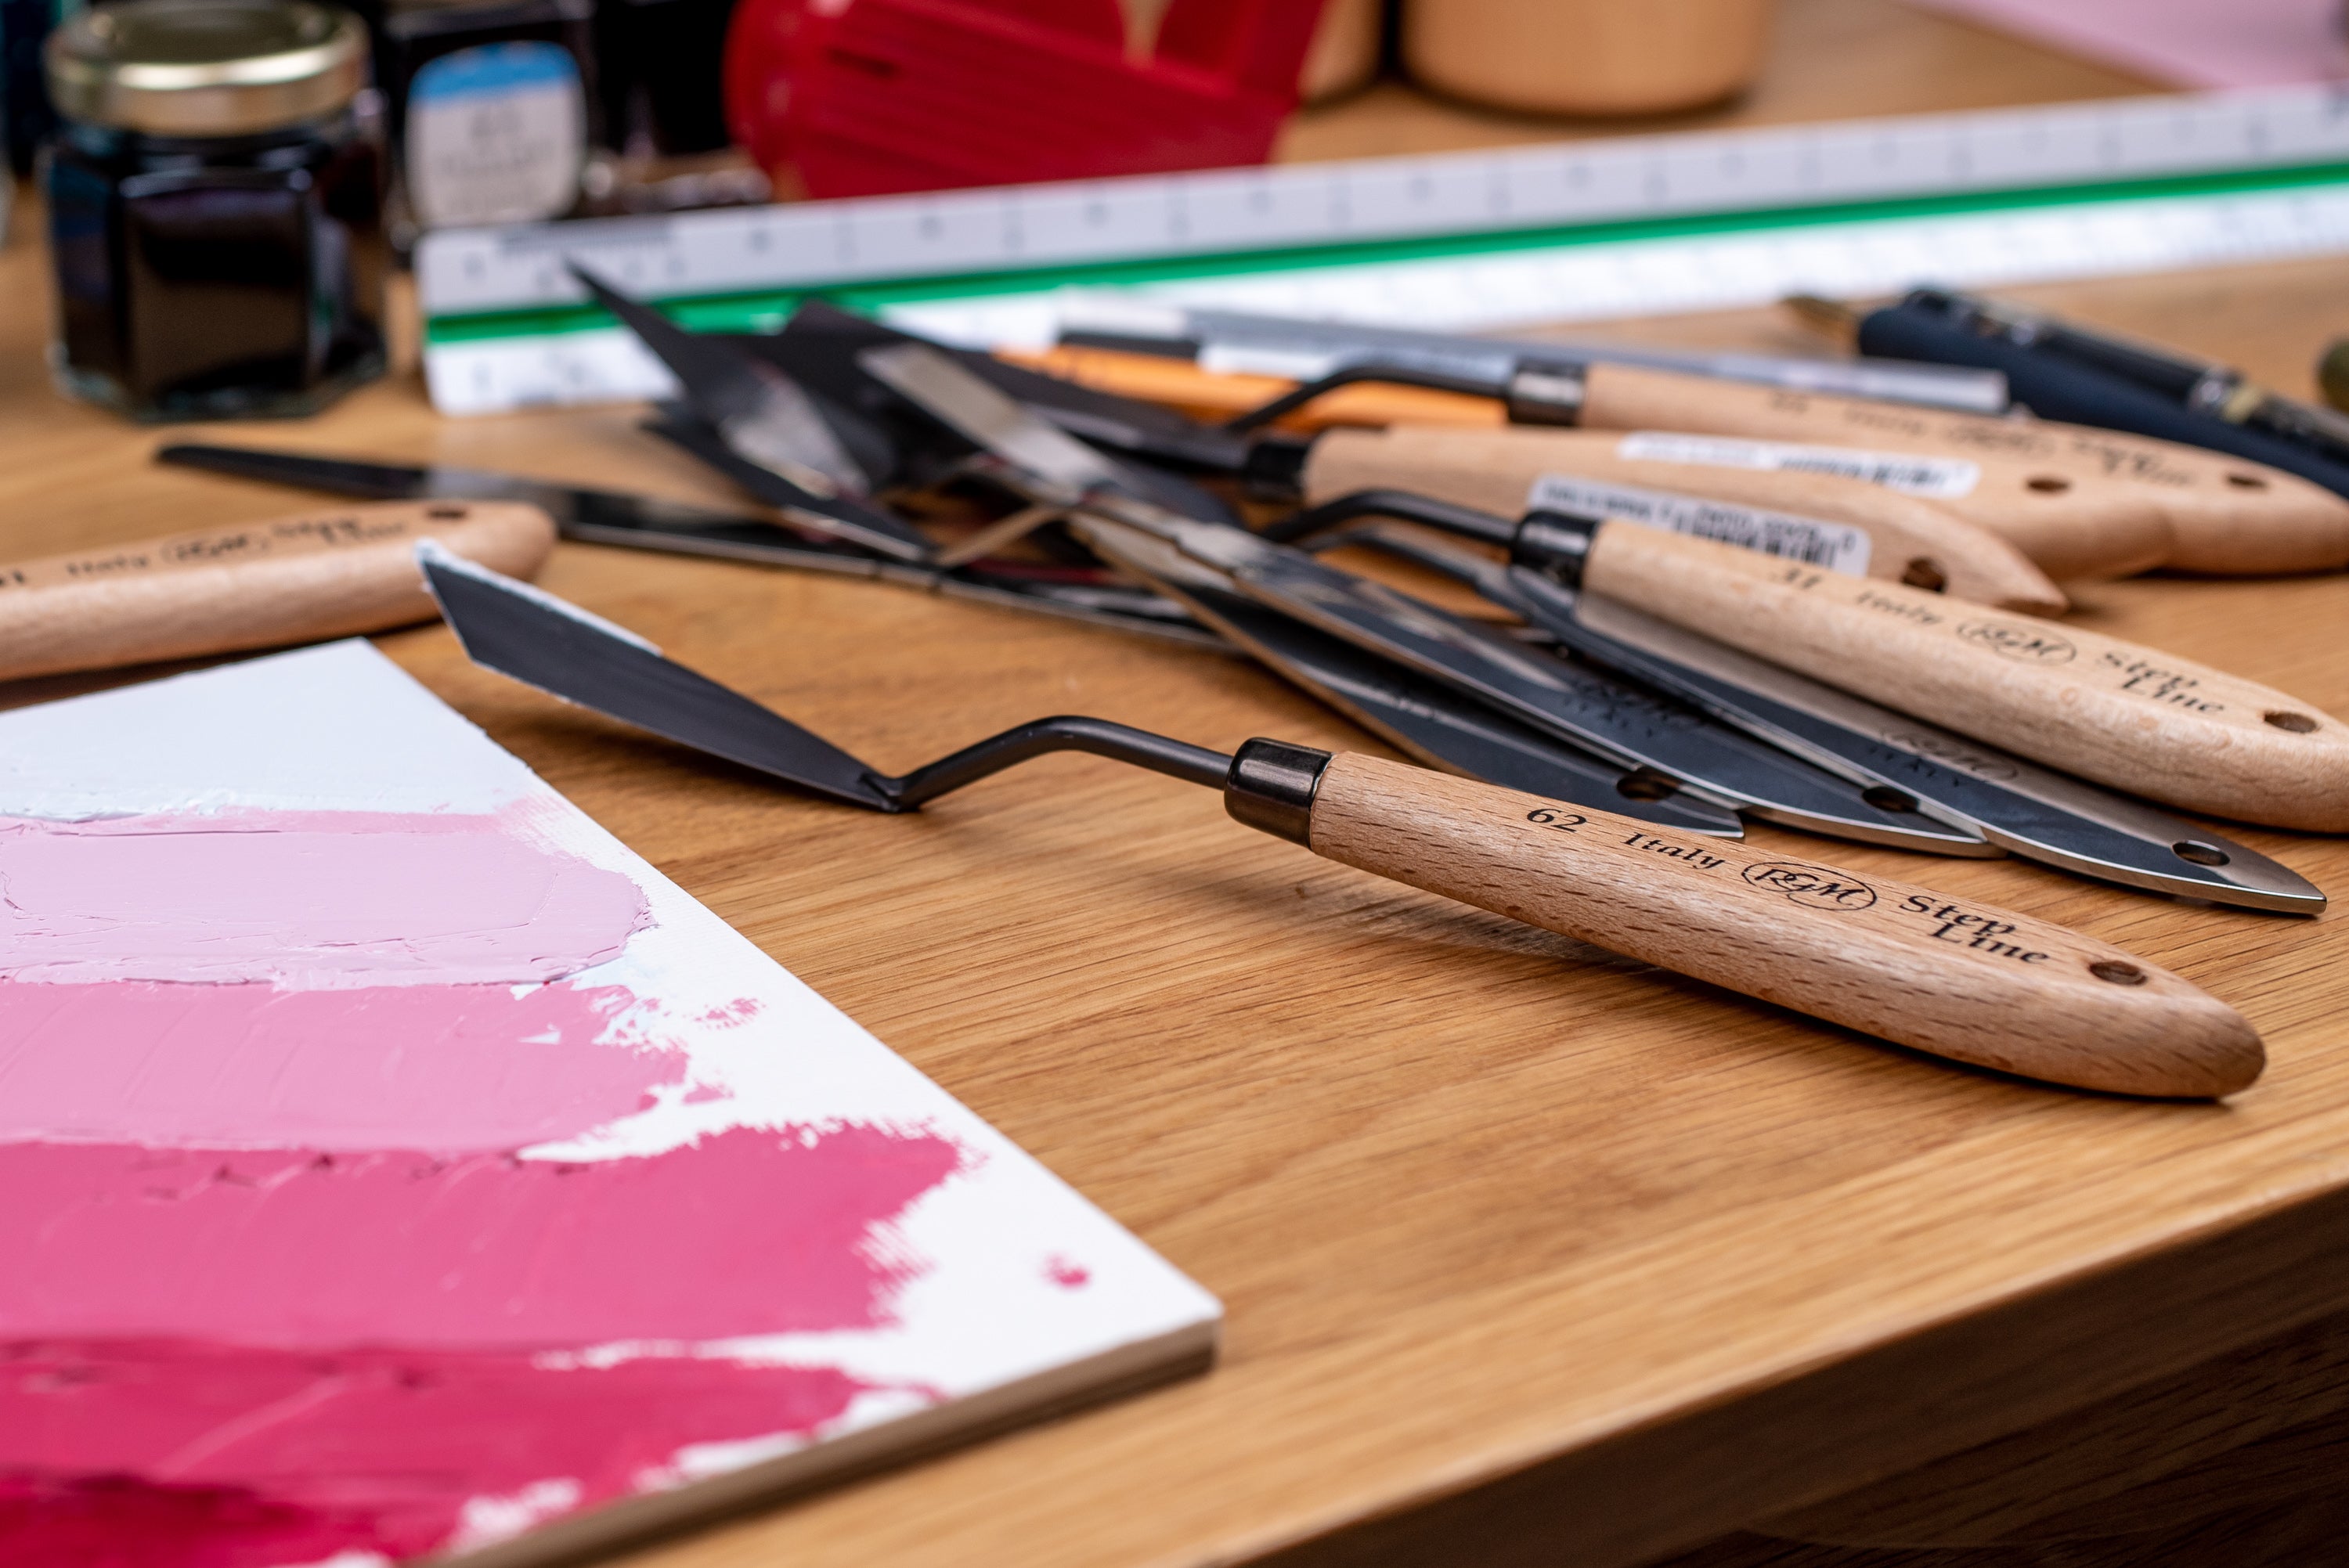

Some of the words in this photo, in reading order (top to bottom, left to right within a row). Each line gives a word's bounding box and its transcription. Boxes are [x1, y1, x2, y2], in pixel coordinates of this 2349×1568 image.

[1526, 808, 1587, 833] 62
[1622, 831, 1726, 869] Italy
[1752, 867, 1867, 907] RGM
[1899, 895, 2016, 938] Step
[1929, 922, 2051, 964] Line
